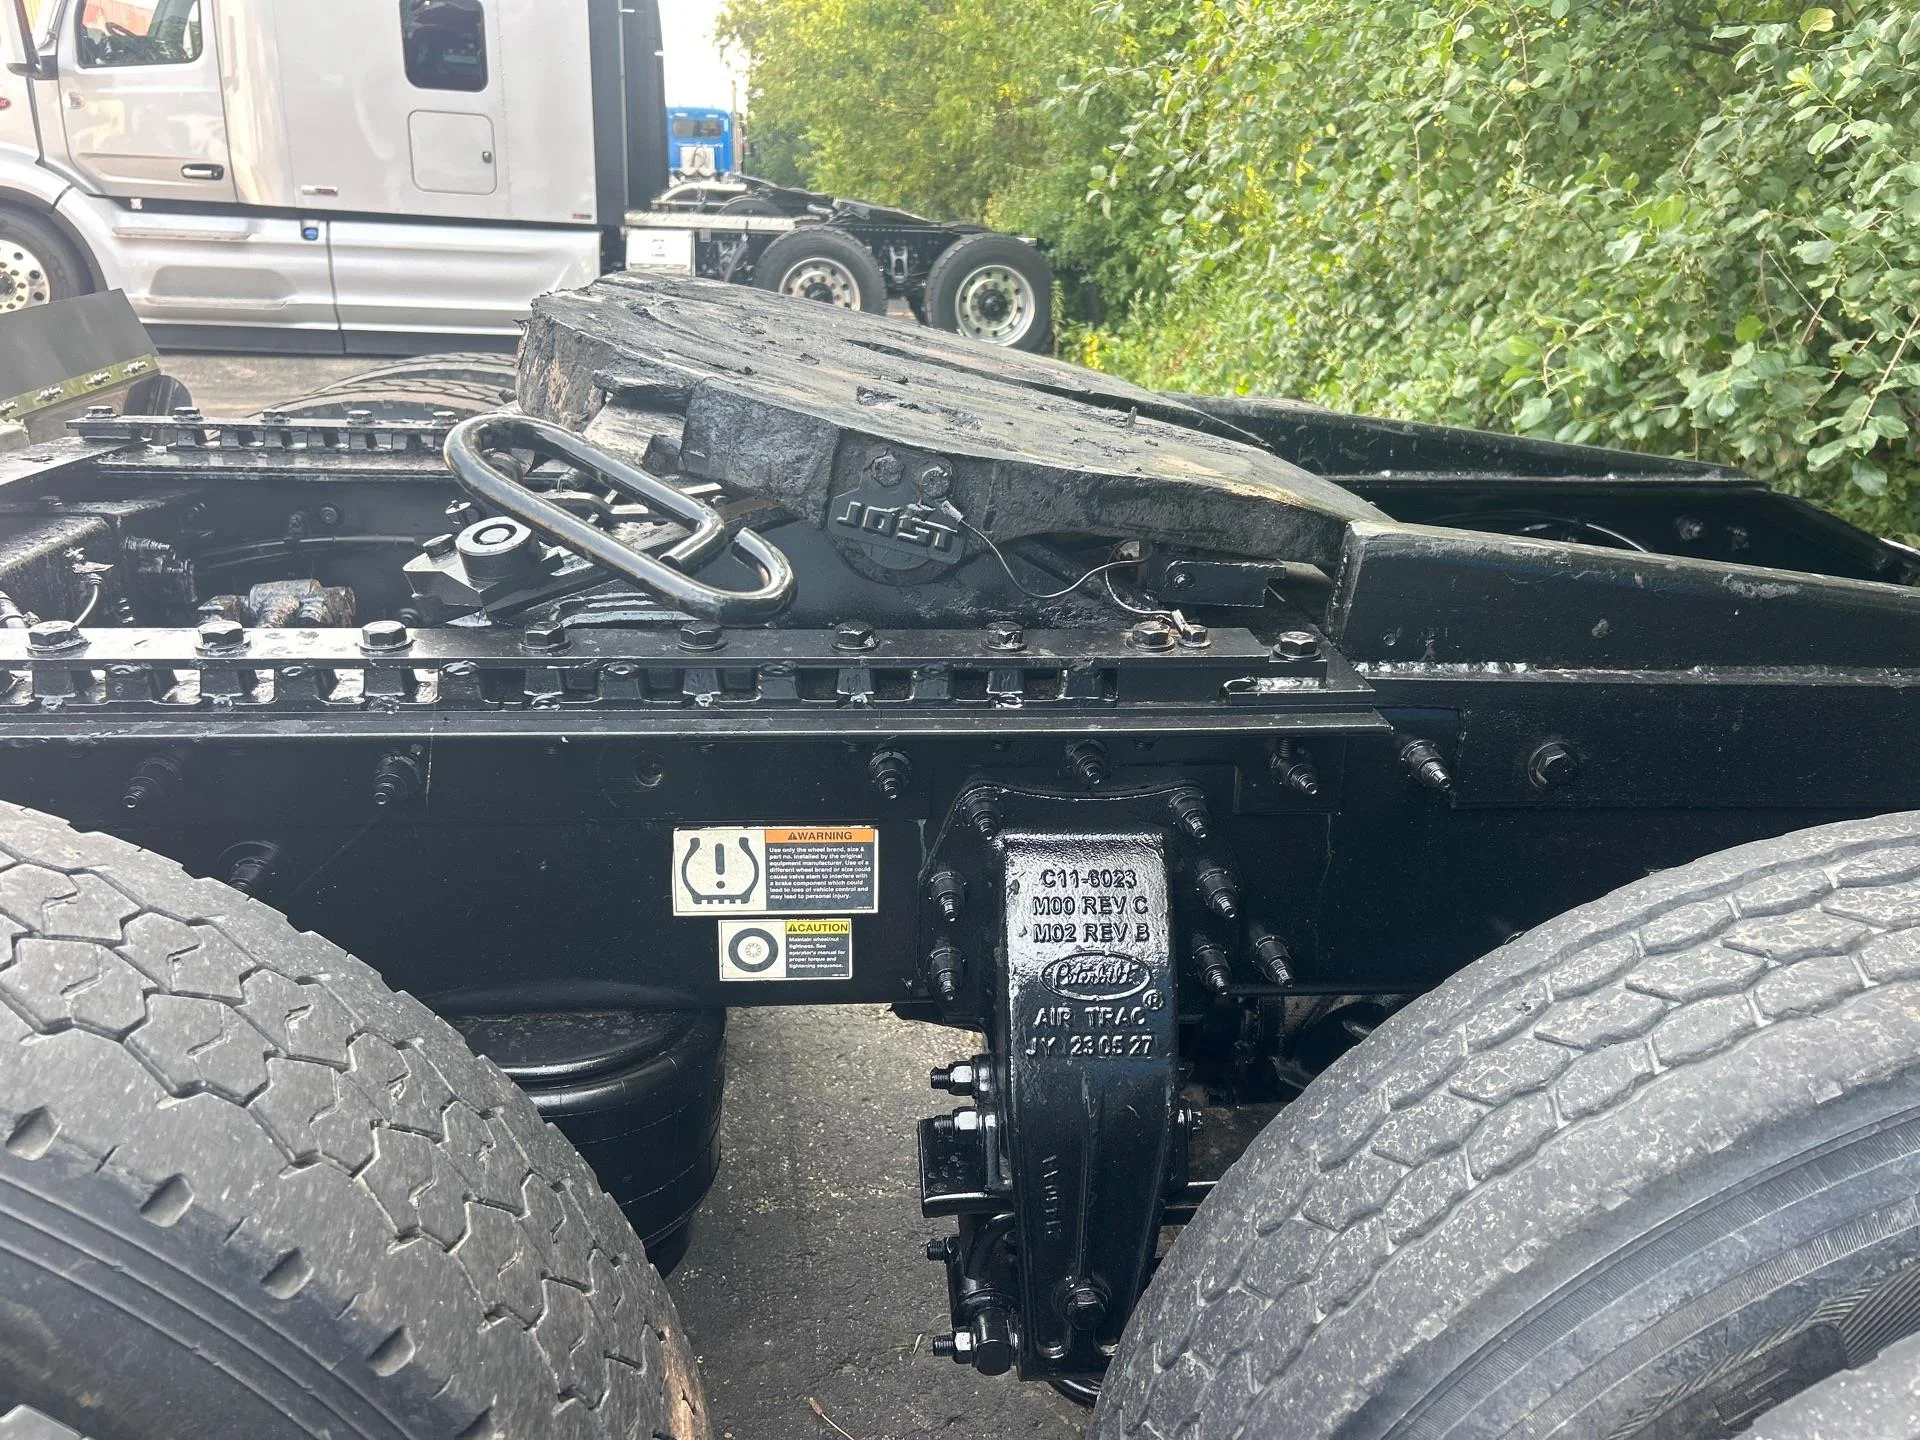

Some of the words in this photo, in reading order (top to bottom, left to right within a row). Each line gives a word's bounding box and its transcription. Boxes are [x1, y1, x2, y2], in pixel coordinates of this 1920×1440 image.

[836, 501, 958, 552] JOST
[798, 832, 852, 840] WARNING
[1041, 869, 1137, 888] C11-6023
[1033, 897, 1075, 915] M00
[1082, 896, 1126, 915] REV
[1133, 896, 1148, 914] C
[1033, 924, 1077, 943] M02
[1083, 924, 1128, 942] REV
[1136, 924, 1150, 941] B
[1033, 1007, 1071, 1027] AIR
[1084, 1006, 1146, 1027] TRAC
[1025, 1036, 1056, 1056] JY
[1129, 1035, 1153, 1054] 27
